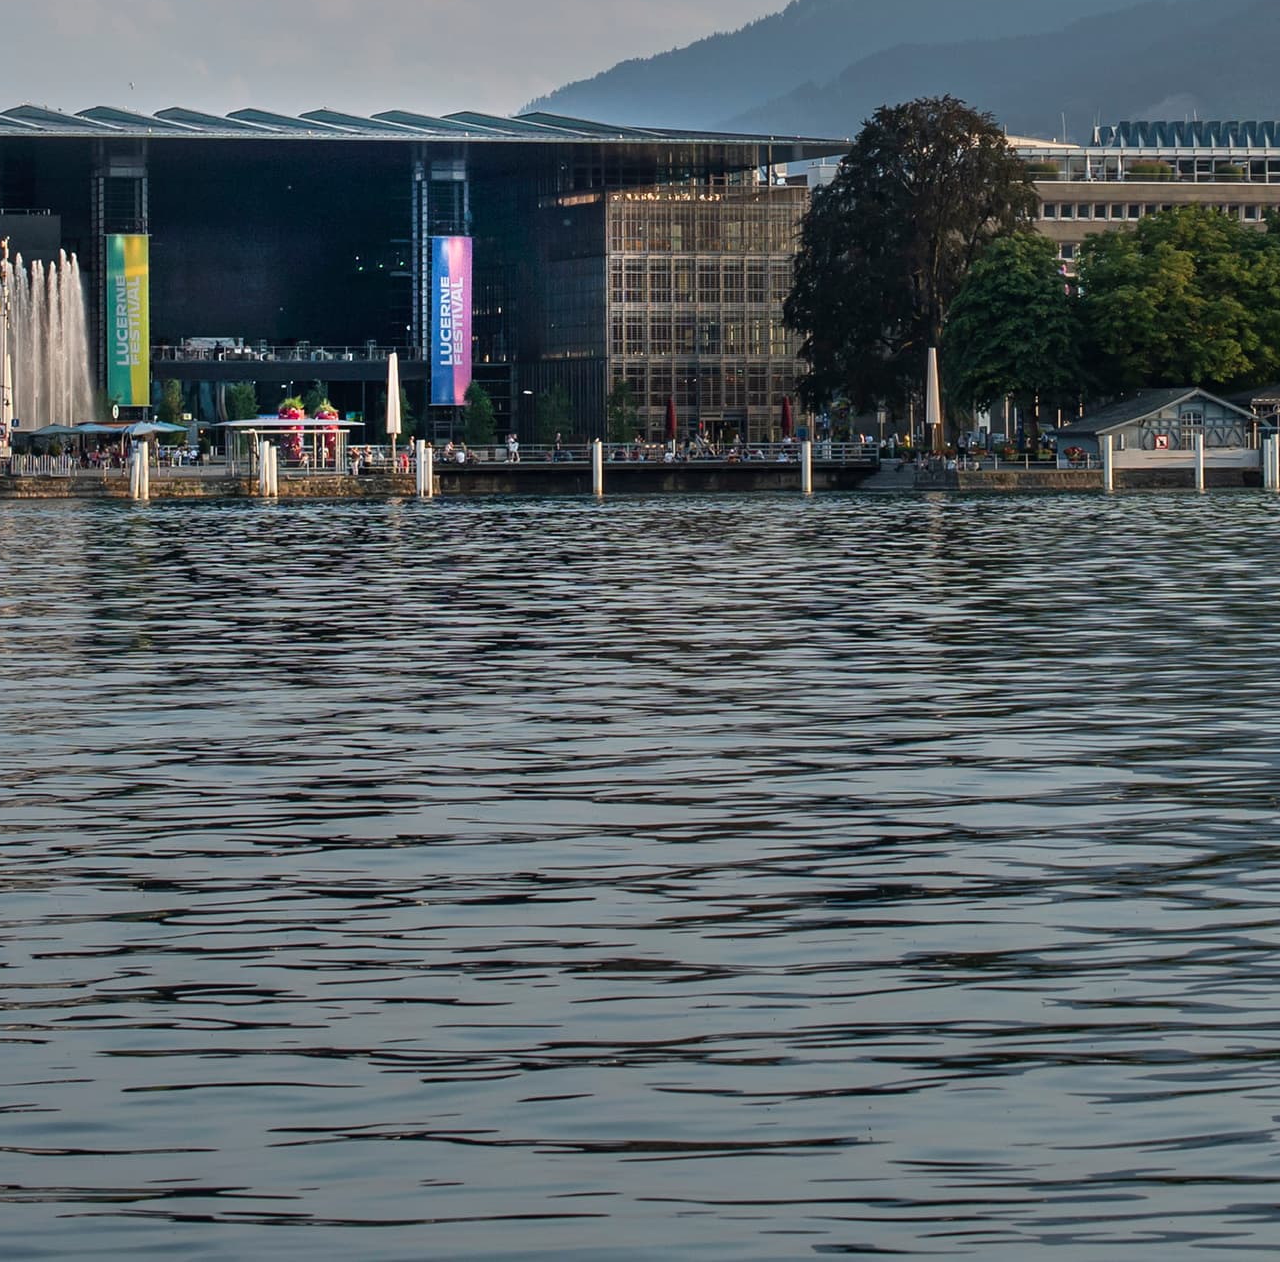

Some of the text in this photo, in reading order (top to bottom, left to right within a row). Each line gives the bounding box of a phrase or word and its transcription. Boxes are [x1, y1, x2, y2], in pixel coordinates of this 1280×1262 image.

[115, 274, 130, 366] LUCERNE
[126, 275, 141, 366] FESTIVAL
[440, 276, 453, 366] LUCERNE
[451, 276, 464, 366] FESTIVAL
